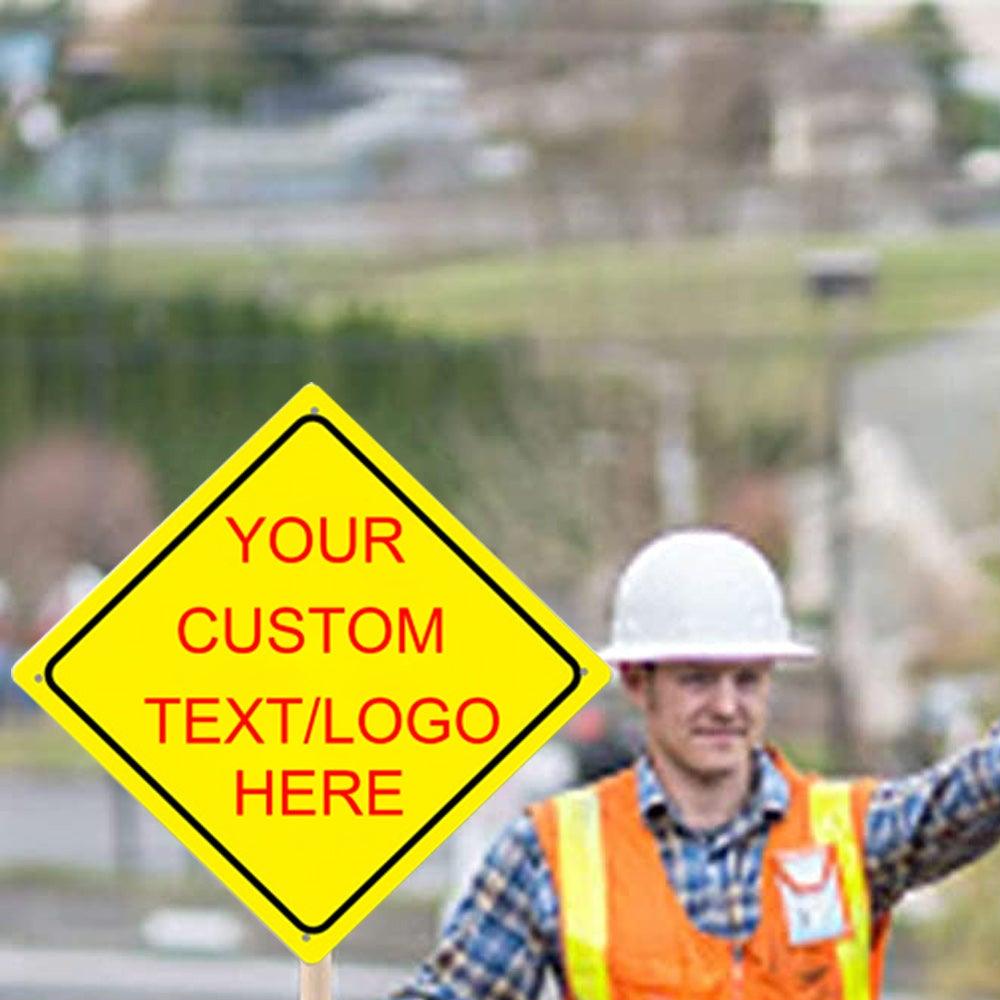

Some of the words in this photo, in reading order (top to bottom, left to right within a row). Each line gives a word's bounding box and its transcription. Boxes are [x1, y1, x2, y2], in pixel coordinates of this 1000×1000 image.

[225, 516, 405, 564] YOUR
[177, 606, 443, 655] CUSTOM
[143, 696, 500, 745] TEXT/LOGO
[236, 769, 404, 817] HERE
